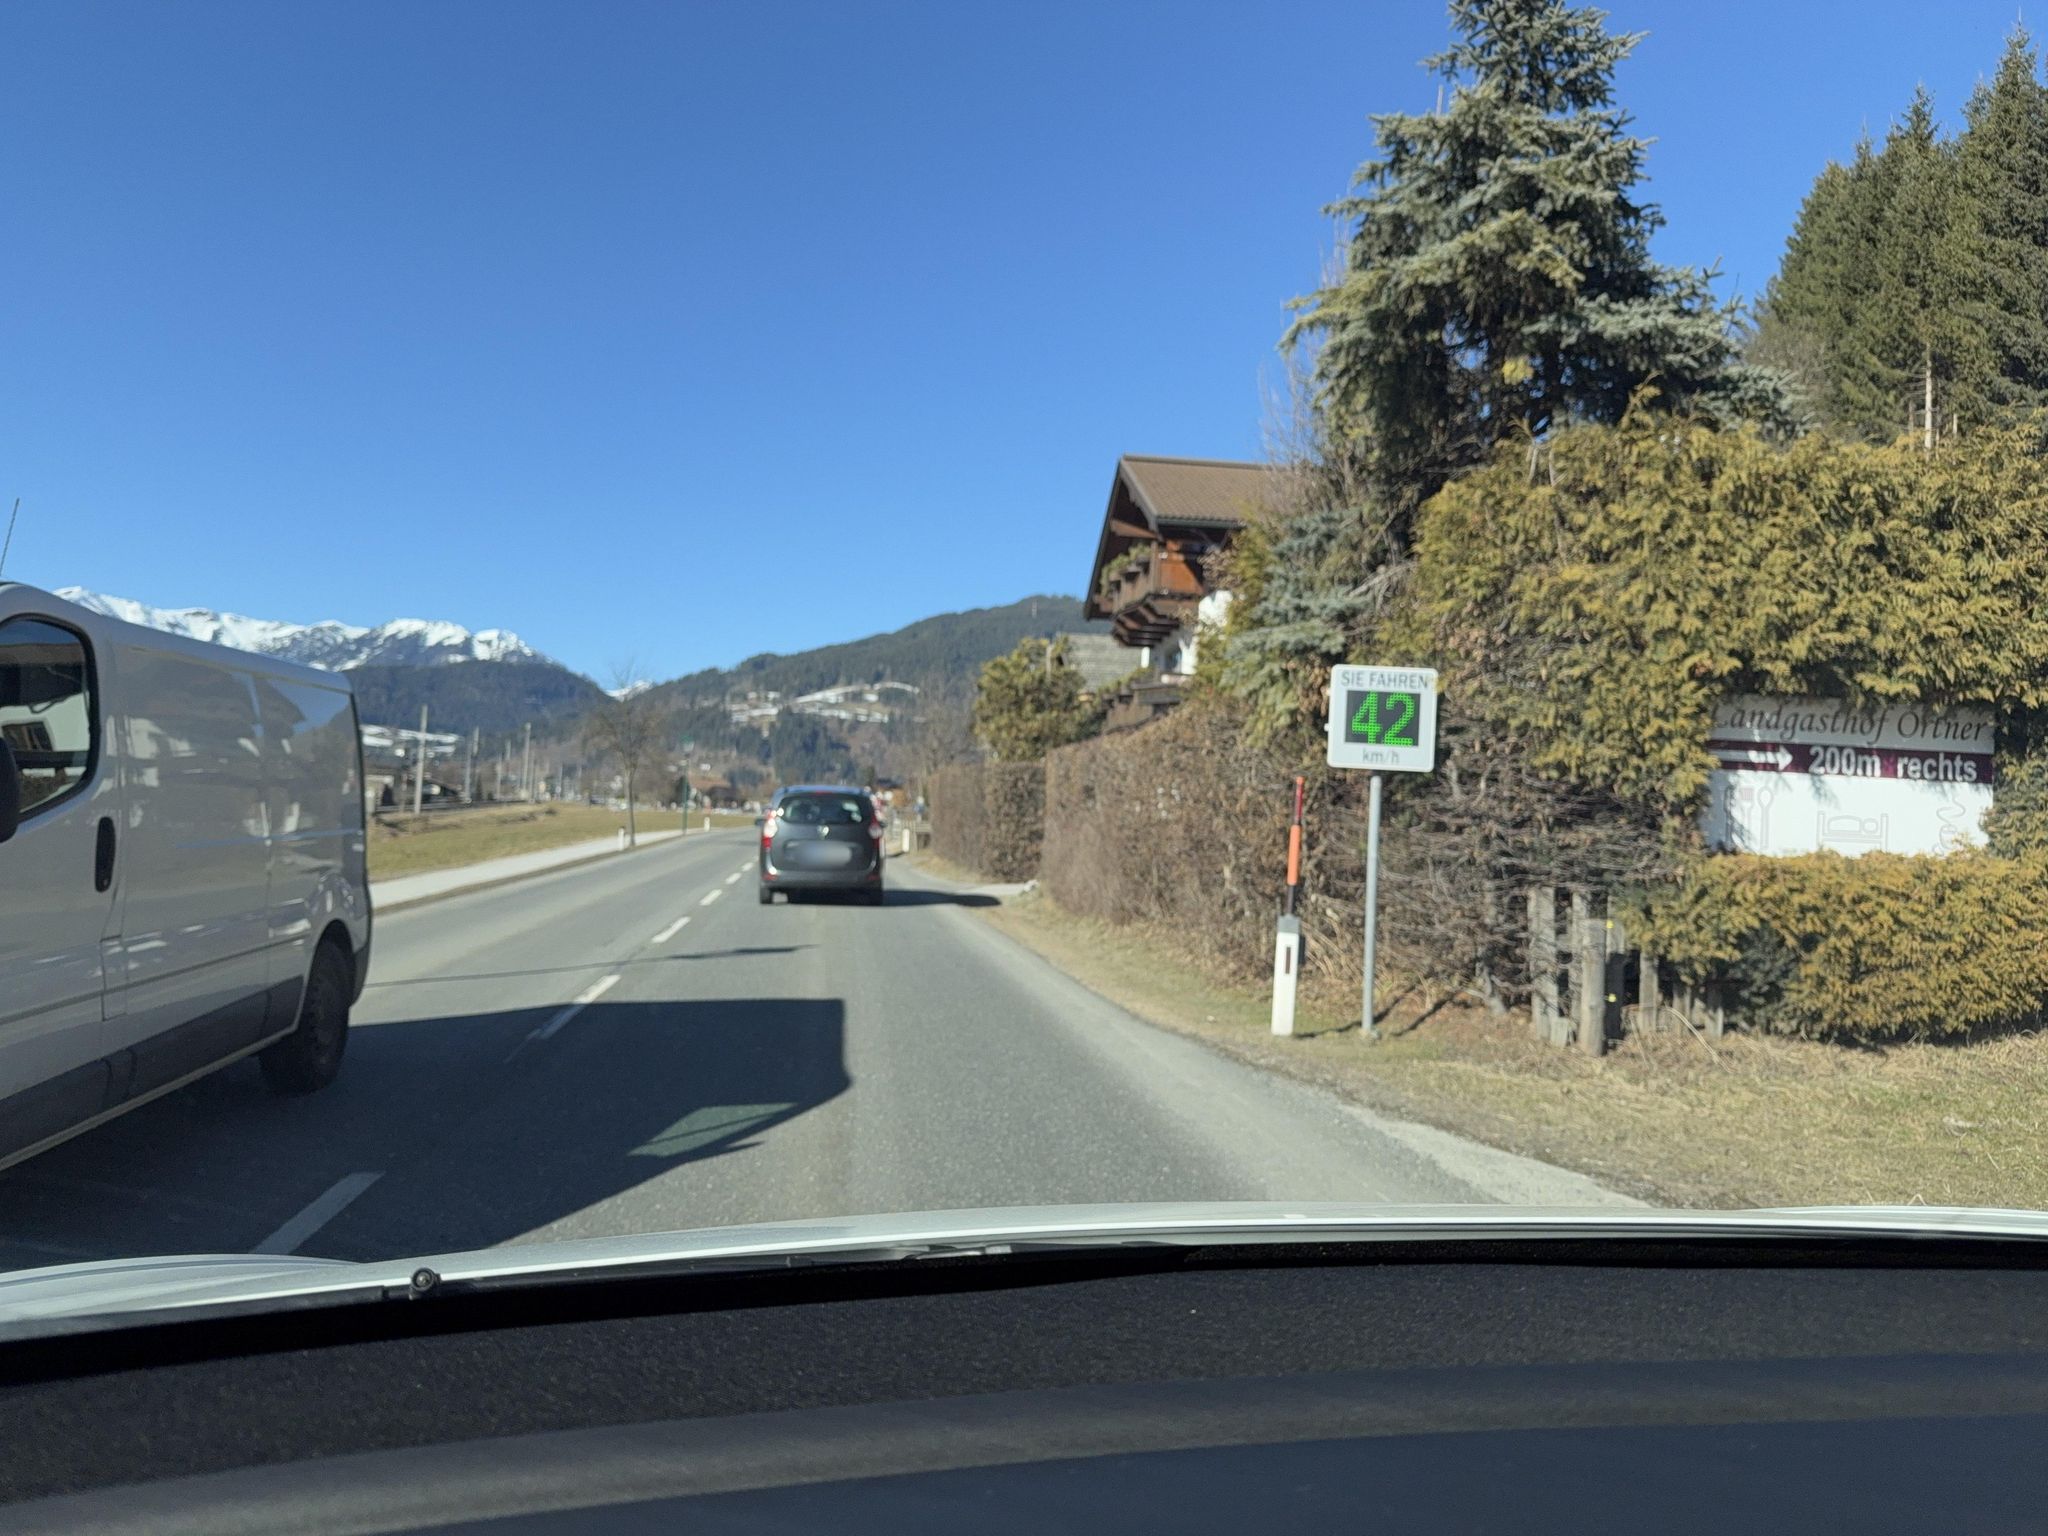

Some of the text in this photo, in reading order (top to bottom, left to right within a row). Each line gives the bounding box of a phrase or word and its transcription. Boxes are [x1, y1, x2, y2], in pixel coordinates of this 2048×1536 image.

[1341, 670, 1428, 689] SIE FAHREN
[1351, 690, 1416, 747] 42
[1710, 703, 1989, 745] Landgasthof Ortner
[1362, 749, 1399, 765] km/h
[1808, 745, 1978, 782] 200m rechts
